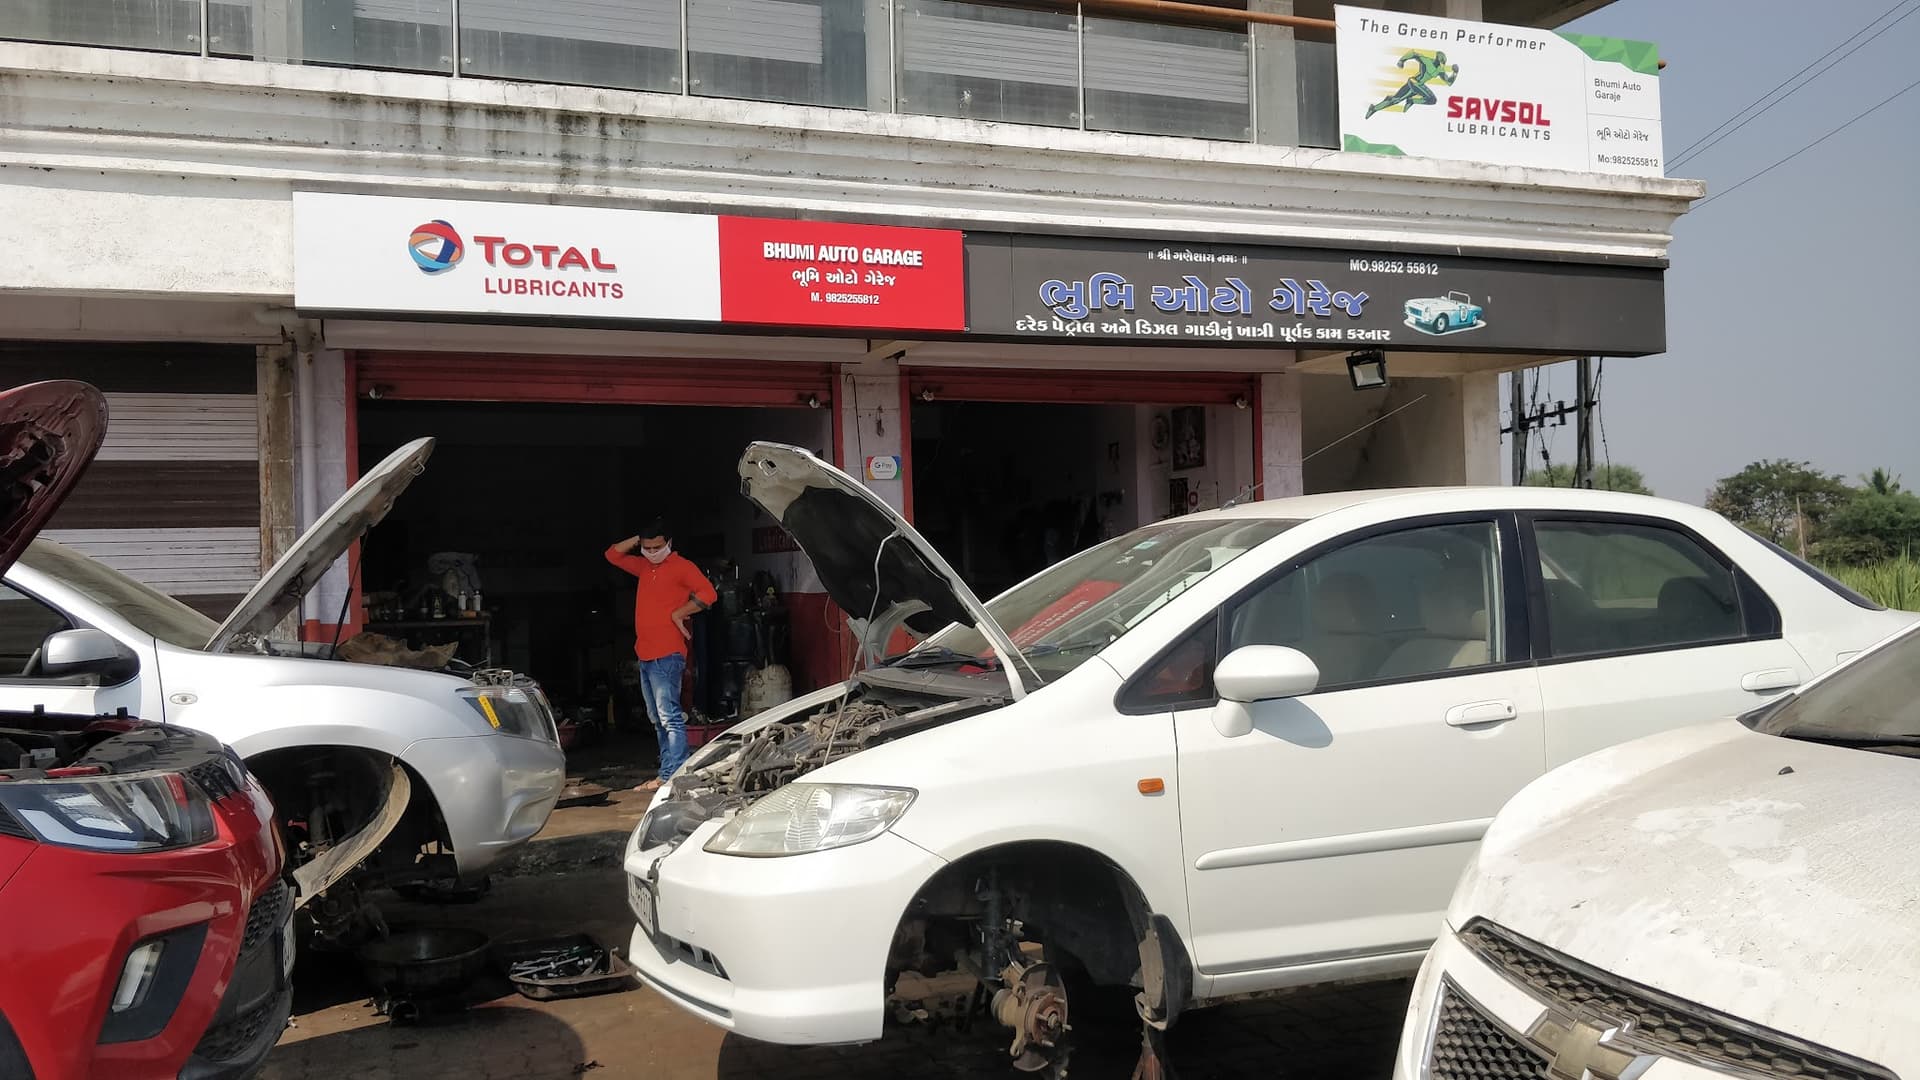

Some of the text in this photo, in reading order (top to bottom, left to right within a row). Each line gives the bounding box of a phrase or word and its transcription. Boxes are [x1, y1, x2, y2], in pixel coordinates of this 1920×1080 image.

[1360, 18, 1546, 51] The Green Performer
[1594, 78, 1642, 91] Bhumi Auto
[1447, 95, 1551, 127] SAVSOL
[1447, 122, 1551, 141] LUBRICANTS
[1597, 154, 1659, 168] Mo:9825255812
[763, 241, 923, 267] BHUMI AUTO GARAGE
[792, 267, 896, 287] ભૂમિ ઓટો ગેરેજ
[1349, 259, 1439, 276] MO.98252 55812
[484, 277, 624, 299] LUBRICANTS
[811, 292, 880, 305] M. 9825255812
[1151, 275, 1252, 314] ઓટો
[1268, 278, 1370, 317] ગેરેજ
[1015, 314, 1049, 332] દરેક
[1101, 318, 1132, 335] અને
[1136, 319, 1179, 336] ડિઝલ
[1184, 321, 1233, 341] ગાડીનું
[1315, 327, 1342, 340] કામ
[1347, 328, 1391, 341] કરનાર
